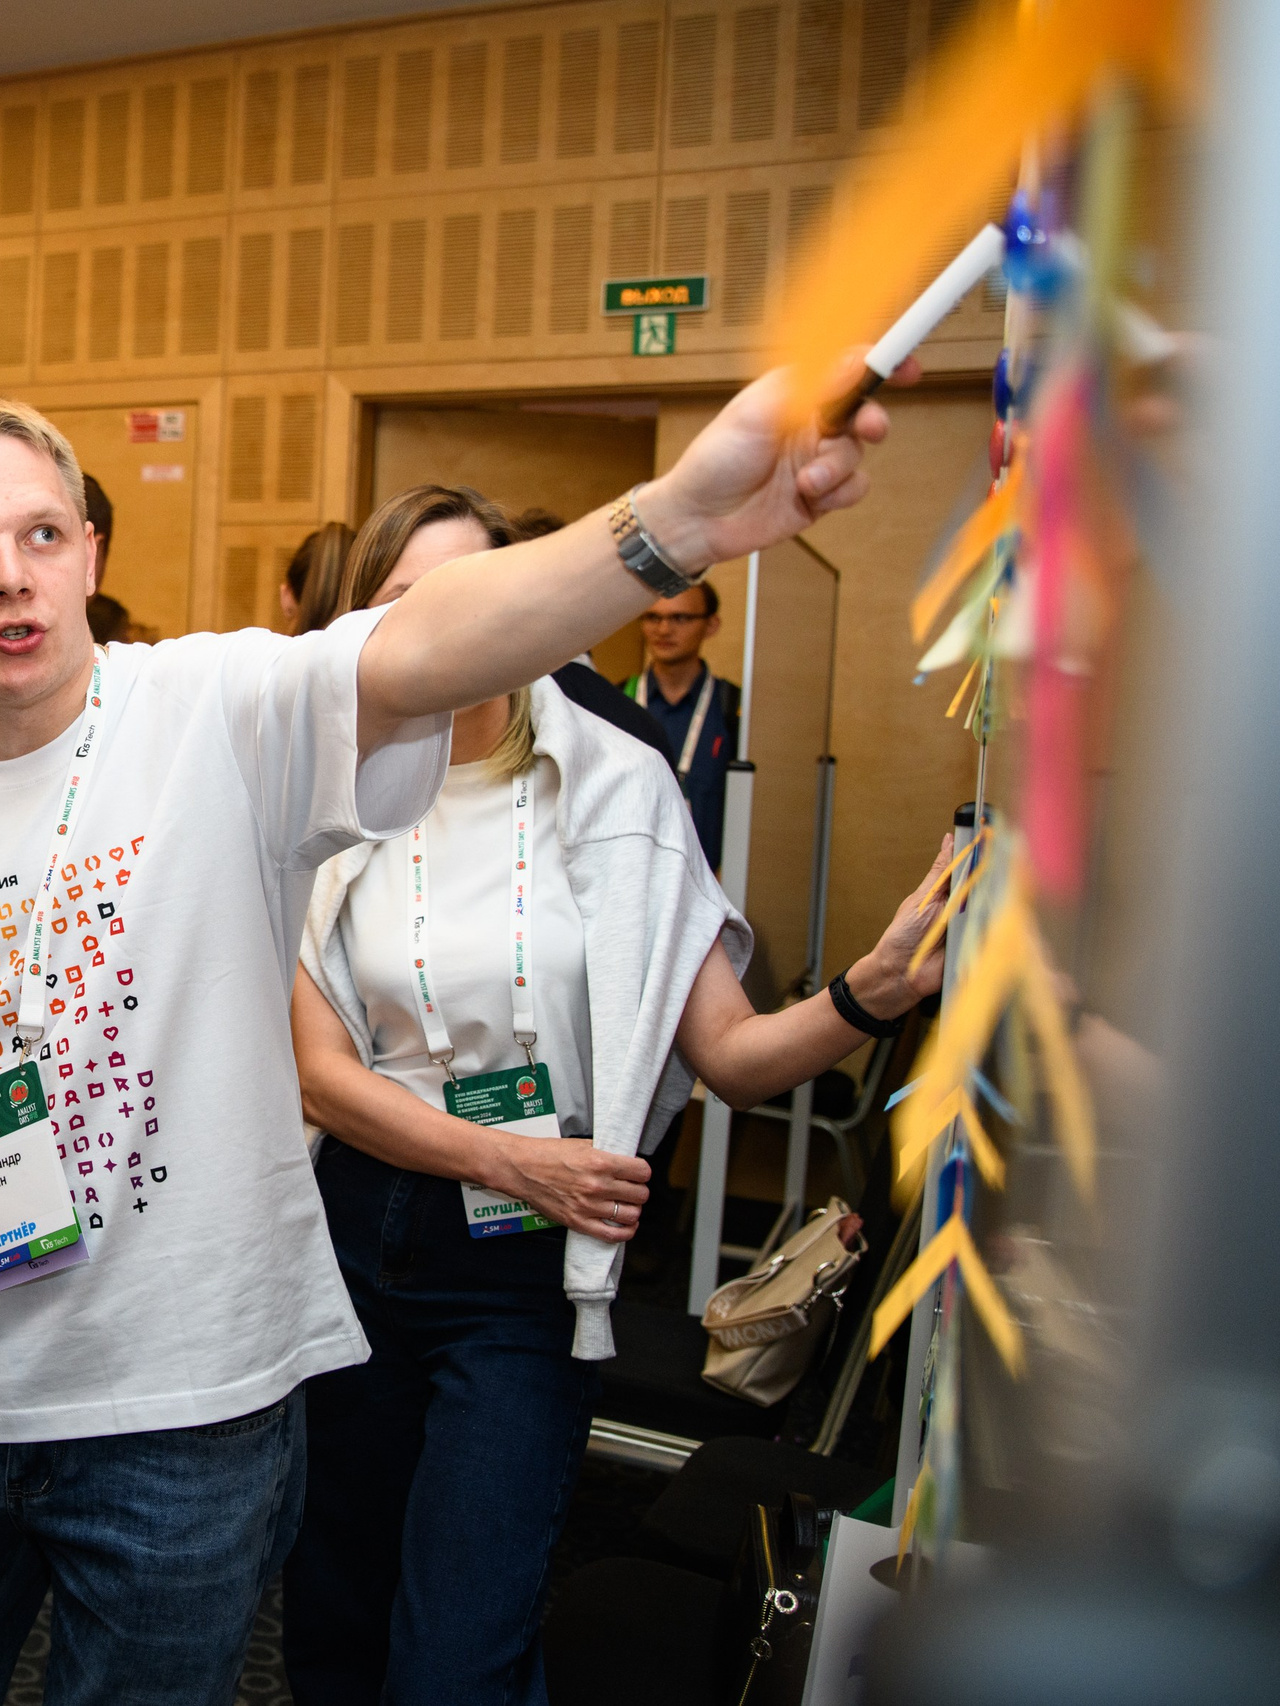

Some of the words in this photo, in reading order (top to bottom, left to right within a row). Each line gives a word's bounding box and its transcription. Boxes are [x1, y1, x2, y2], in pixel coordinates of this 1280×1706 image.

[84, 724, 96, 742] Tech
[72, 776, 80, 786] #18
[68, 787, 78, 800] DAYS
[62, 800, 73, 822] ANALYST
[33, 935, 42, 960] ANALYST
[418, 971, 428, 992] ANALYST
[18, 1102, 37, 1118] ANALYST
[523, 1098, 543, 1108] ANALYST
[524, 1108, 536, 1116] DAYS
[18, 1114, 30, 1125] DAYS
[473, 1200, 534, 1218] СЛУШАТ
[54, 1236, 68, 1246] Tech
